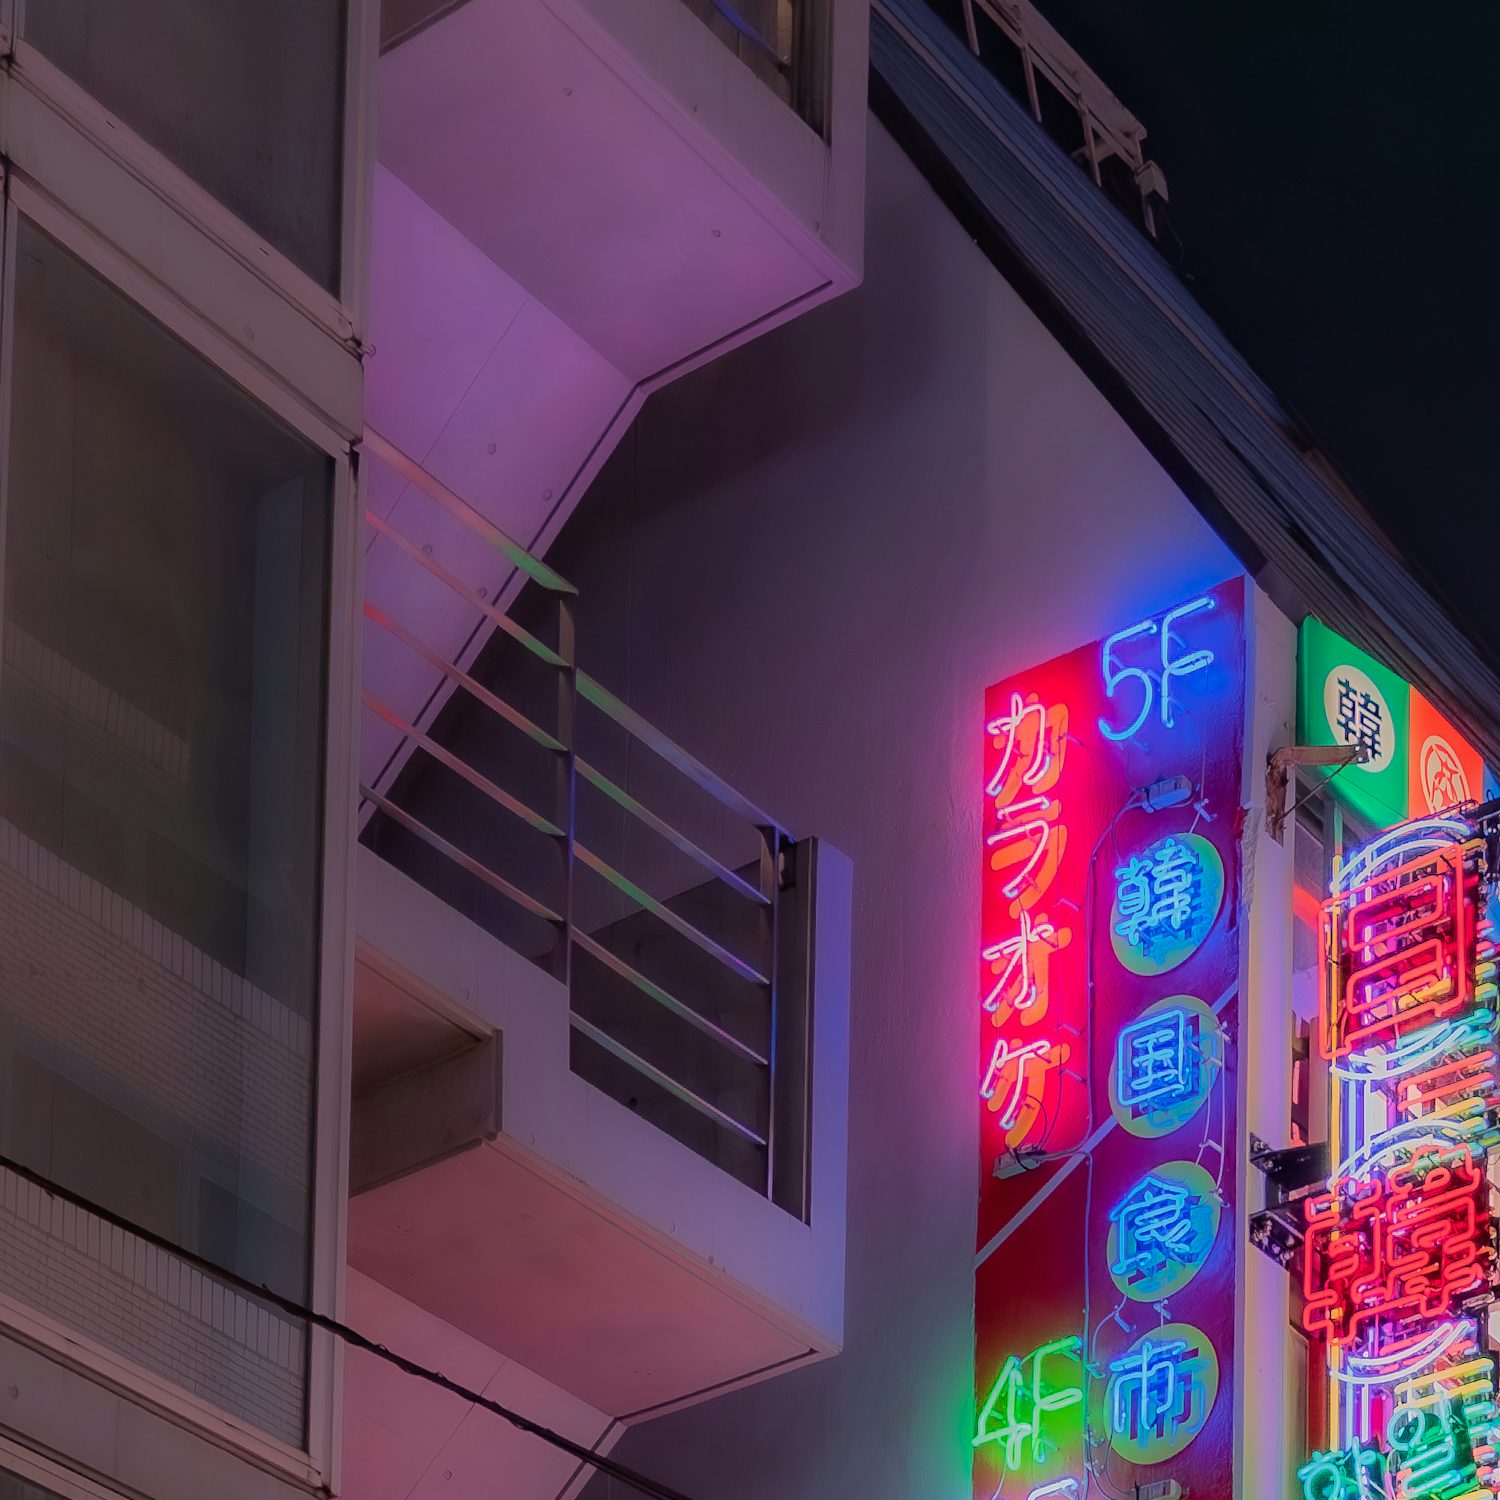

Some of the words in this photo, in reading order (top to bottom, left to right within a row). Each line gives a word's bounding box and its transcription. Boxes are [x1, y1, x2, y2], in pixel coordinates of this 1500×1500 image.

[1100, 595, 1214, 741] 5F
[1336, 676, 1384, 763] 韓
[980, 693, 1069, 1140] カラオケ
[972, 1334, 1083, 1470] 4F
